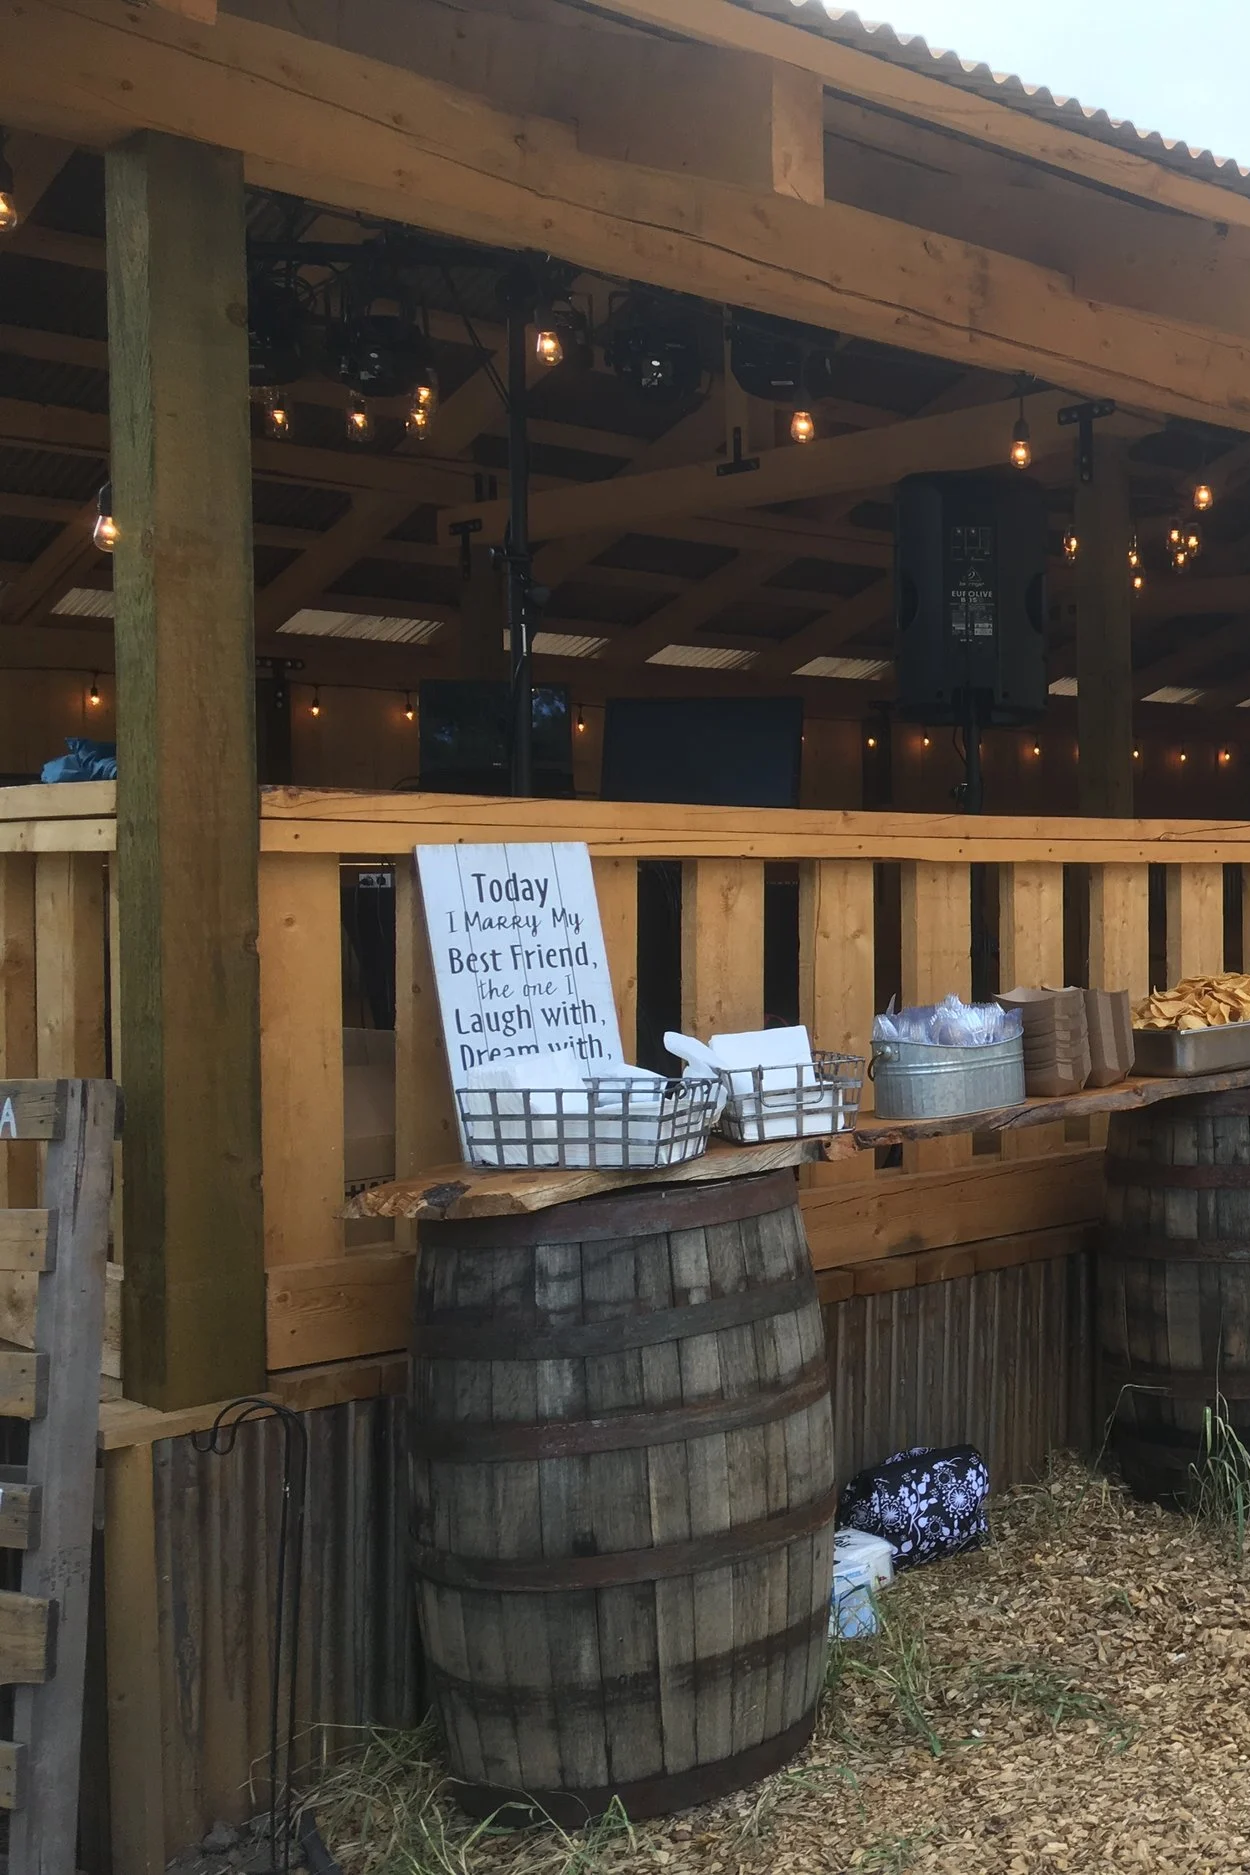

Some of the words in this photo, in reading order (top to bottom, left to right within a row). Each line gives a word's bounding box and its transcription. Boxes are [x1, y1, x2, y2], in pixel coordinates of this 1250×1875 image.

[471, 872, 549, 908] Today
[445, 910, 458, 933] I
[552, 907, 584, 935] My
[448, 947, 503, 975] Best
[509, 941, 599, 970] Friend,
[477, 978, 515, 1001] the
[523, 979, 557, 998] one
[565, 974, 575, 996] I
[455, 1003, 533, 1037] Laugh
[541, 999, 606, 1029] with,
